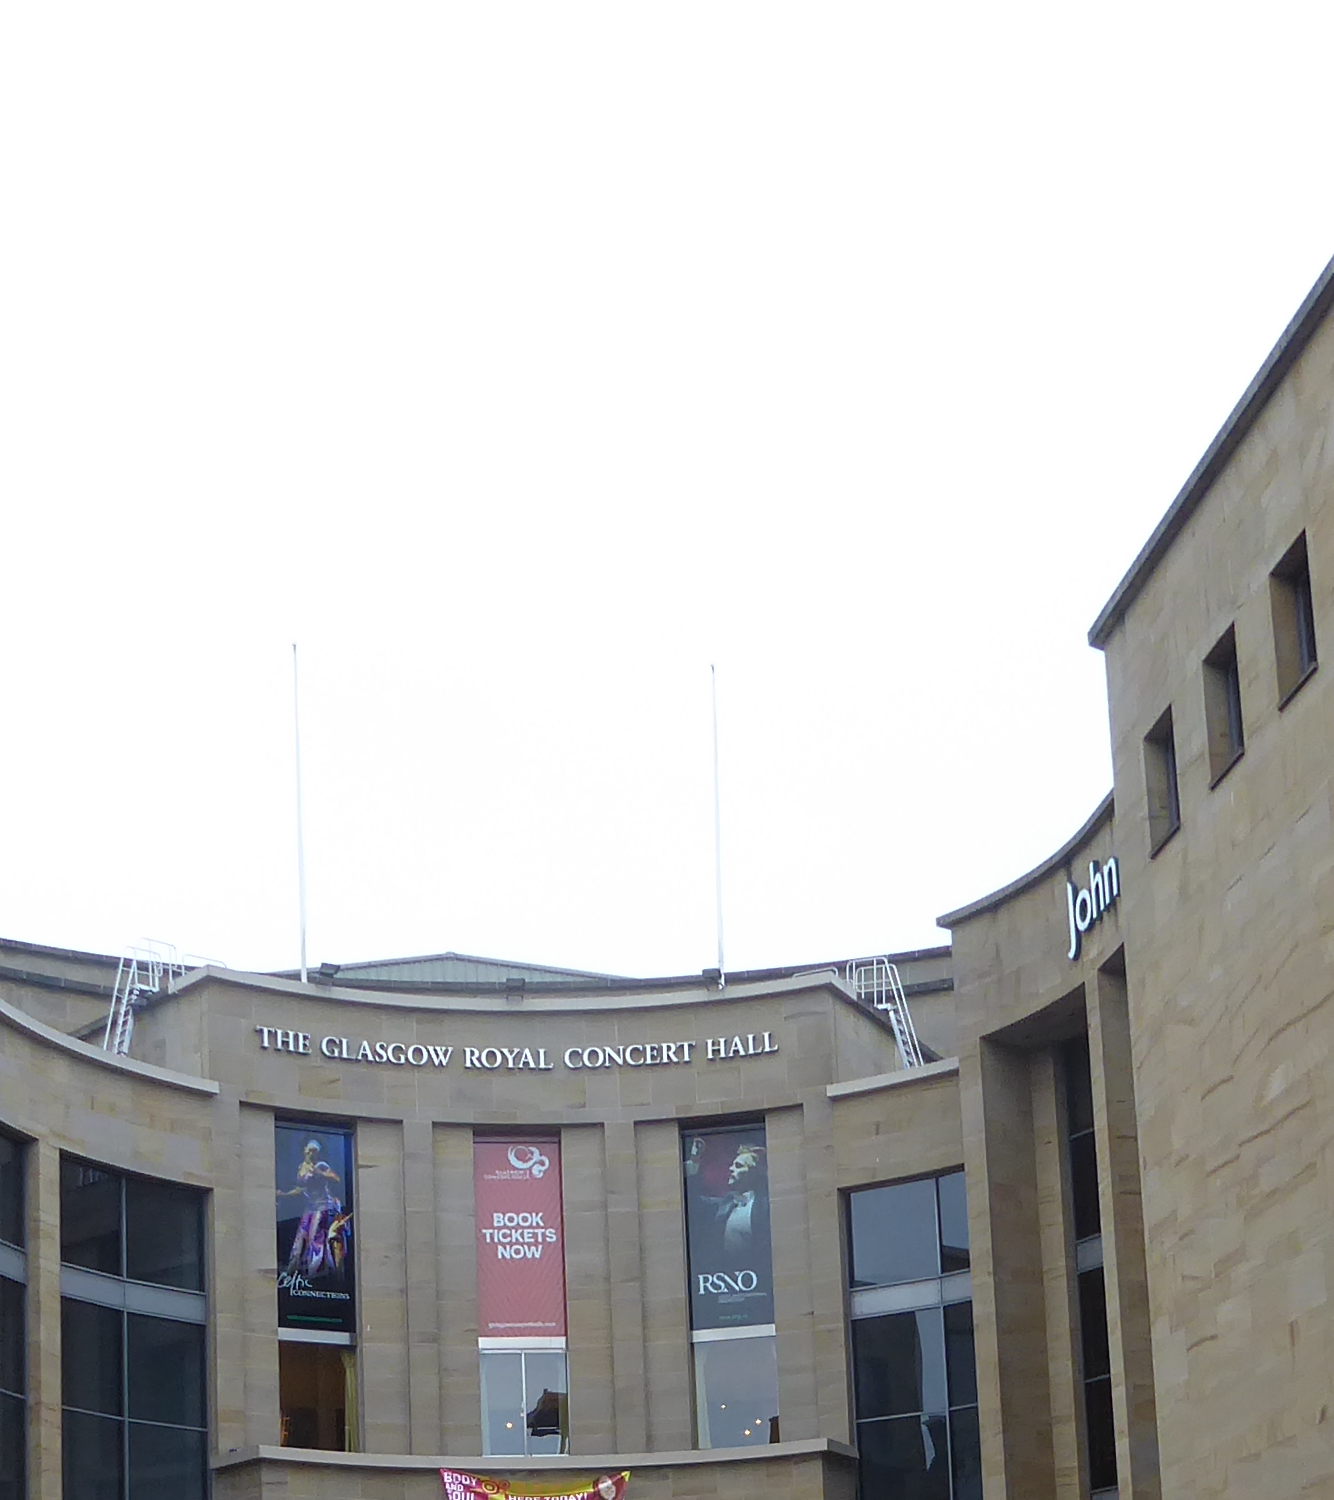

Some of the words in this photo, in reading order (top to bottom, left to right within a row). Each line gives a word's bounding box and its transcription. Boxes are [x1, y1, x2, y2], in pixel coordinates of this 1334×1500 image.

[1067, 856, 1120, 960] John
[255, 1025, 312, 1055] THE
[320, 1036, 454, 1069] GLASGOW
[463, 1046, 554, 1071] ROYAL
[564, 1040, 696, 1070] CONCERT
[706, 1031, 779, 1061] HALL
[493, 1212, 544, 1227] BOOK
[482, 1228, 557, 1243] TICKETS
[497, 1244, 543, 1259] NOW
[697, 1269, 758, 1295] RSNO
[443, 1471, 478, 1486] BODY
